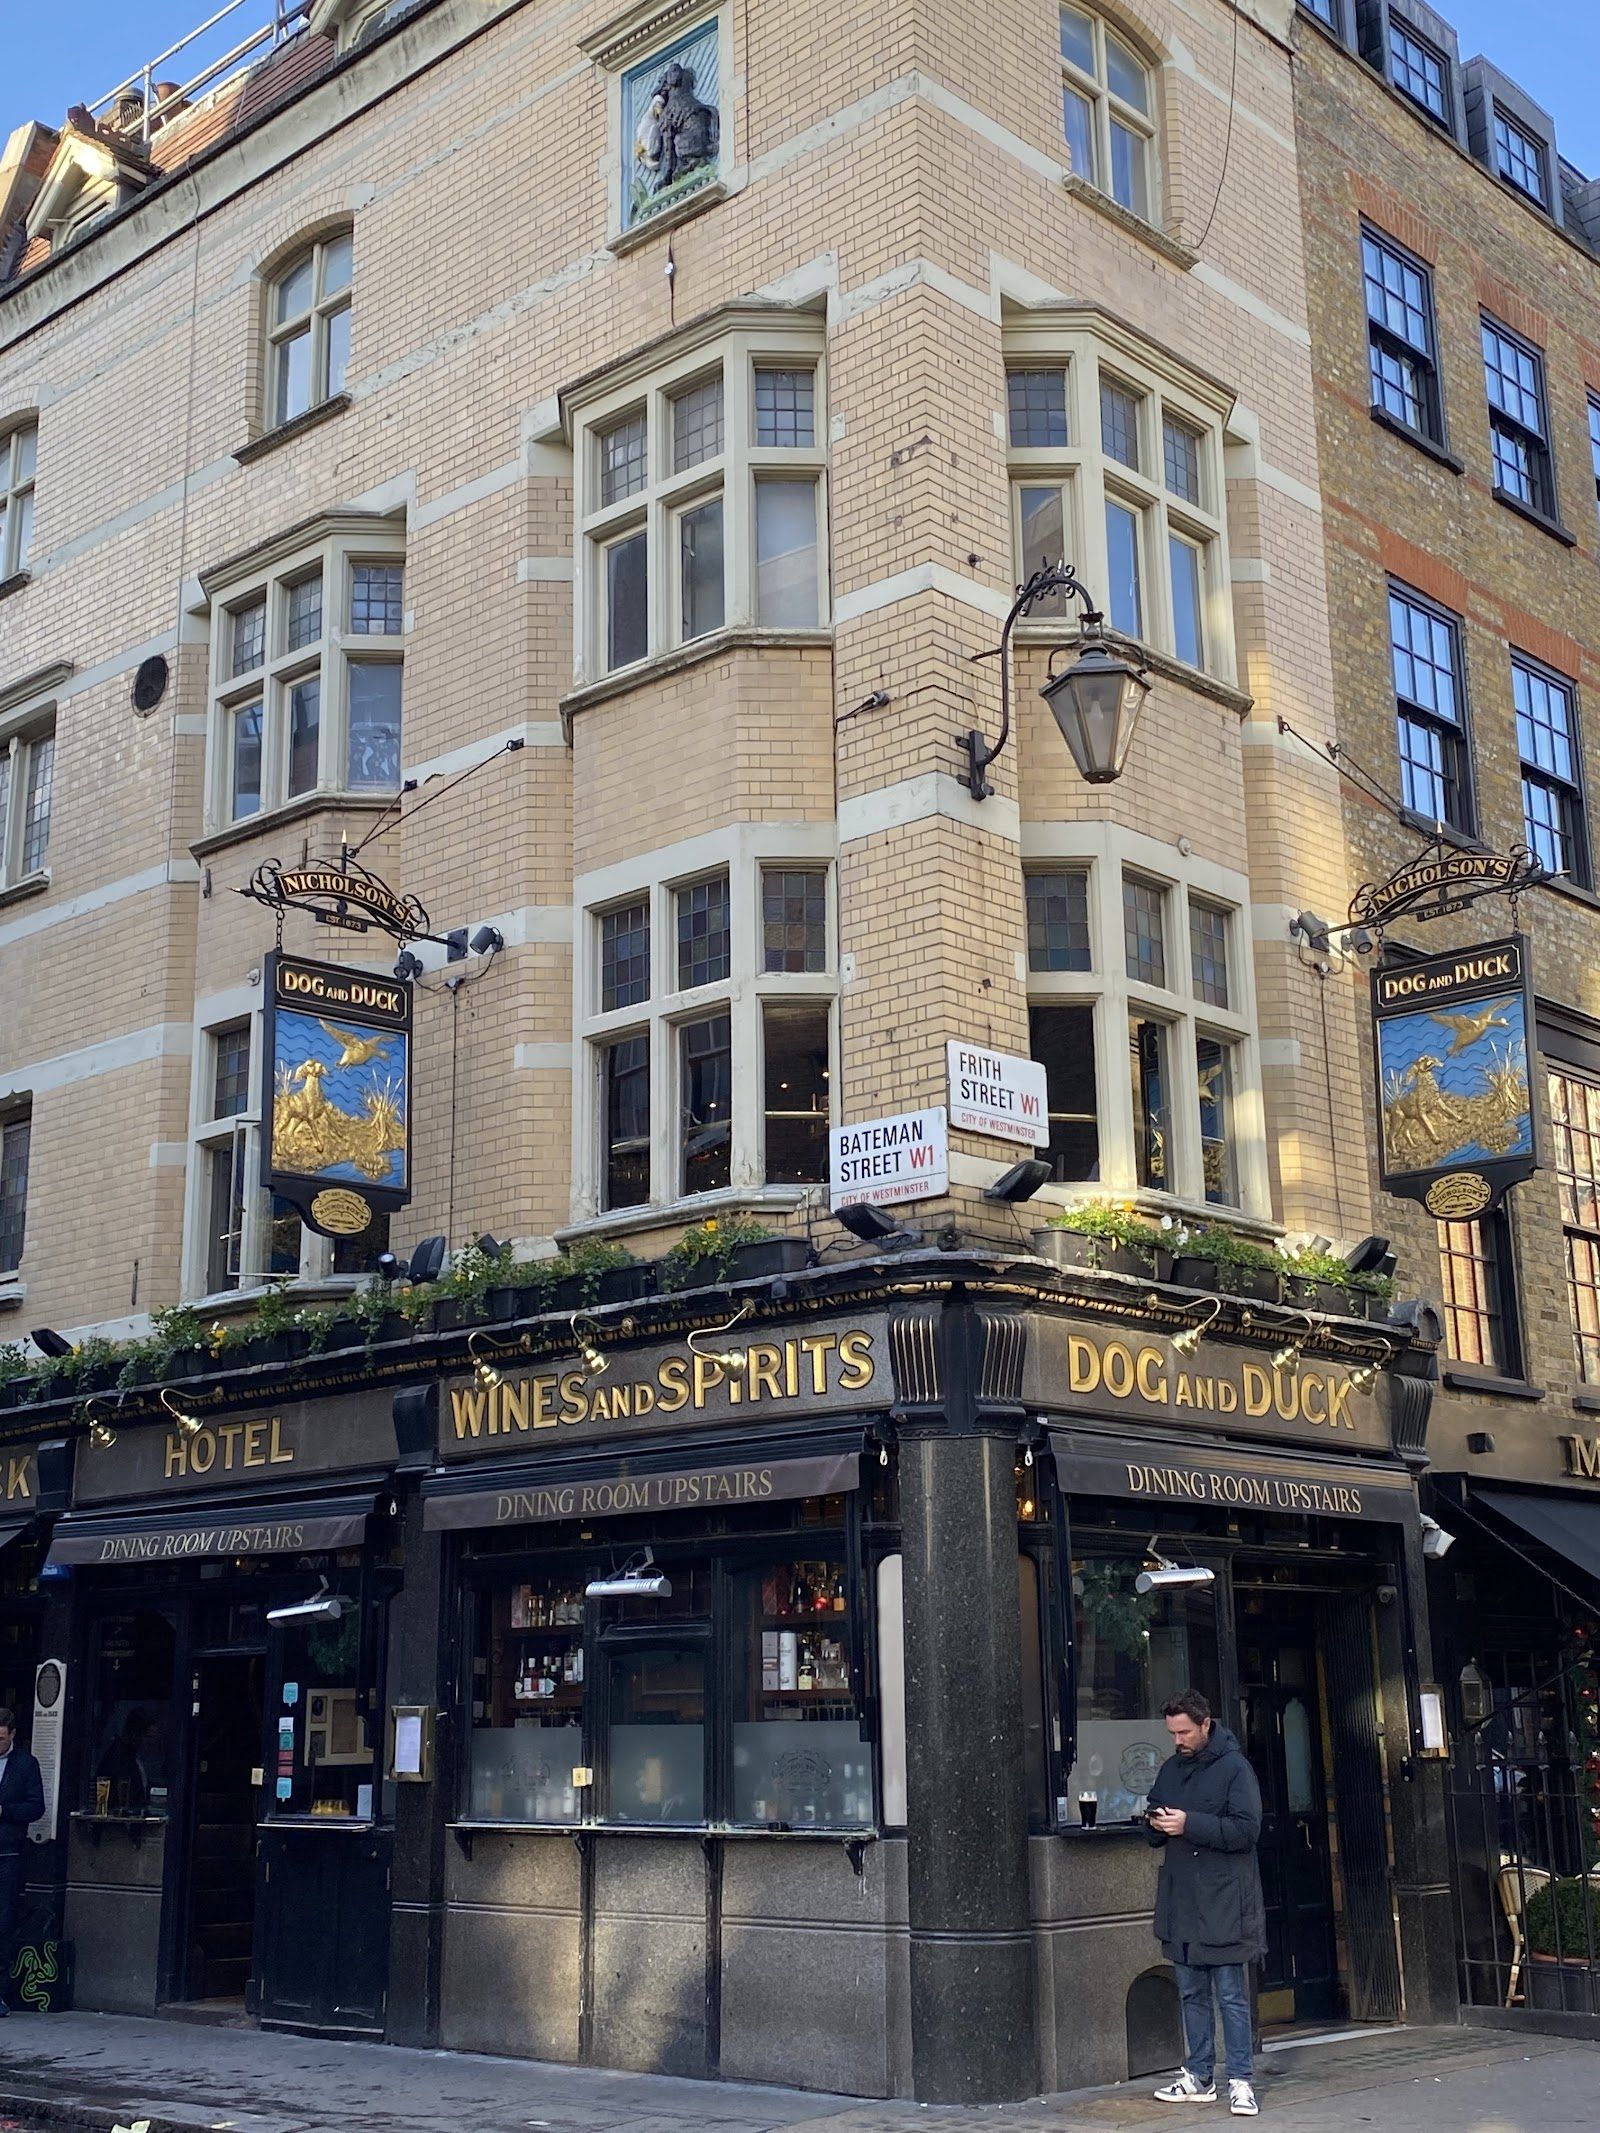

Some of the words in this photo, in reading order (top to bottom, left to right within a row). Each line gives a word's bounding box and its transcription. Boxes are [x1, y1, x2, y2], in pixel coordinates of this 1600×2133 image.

[284, 874, 406, 920] NICHOLSON'S
[1377, 859, 1508, 908] NICHOLSON'S
[284, 970, 325, 996] DOG
[327, 987, 348, 1001] AND
[351, 984, 399, 1012] DUCK
[1385, 974, 1426, 999] DOG
[1429, 975, 1452, 989] AND
[1455, 955, 1511, 984] DUCK
[960, 1052, 1001, 1081] FRITH
[961, 1079, 1015, 1111] STREET
[1021, 1092, 1040, 1118] W1
[840, 1119, 923, 1156] BATEMAN
[961, 1113, 977, 1125] CITY
[979, 1116, 988, 1127] OF
[989, 1119, 1036, 1139] WESTMINSTER
[841, 1152, 902, 1183] STREET
[909, 1145, 935, 1169] W1
[861, 1191, 871, 1203] OF
[872, 1181, 929, 1201] WESTMINSTER
[1068, 1333, 1168, 1405] DOG
[1175, 1373, 1239, 1413] AND
[1242, 1362, 1355, 1431] DUCK
[451, 1370, 589, 1440] WINES
[590, 1382, 655, 1422] AND
[164, 1416, 294, 1478] HOTEL
[496, 1489, 574, 1521] DINING
[581, 1480, 650, 1513] ROOM
[658, 1469, 773, 1504] UPSTAIRS
[1127, 1464, 1207, 1500] DINING
[1211, 1474, 1271, 1507] ROOM
[1274, 1480, 1362, 1514] UPSTAIRS
[101, 1537, 159, 1561] DINING
[161, 1530, 216, 1556] ROOM
[218, 1525, 303, 1552] UPSTAIRS
